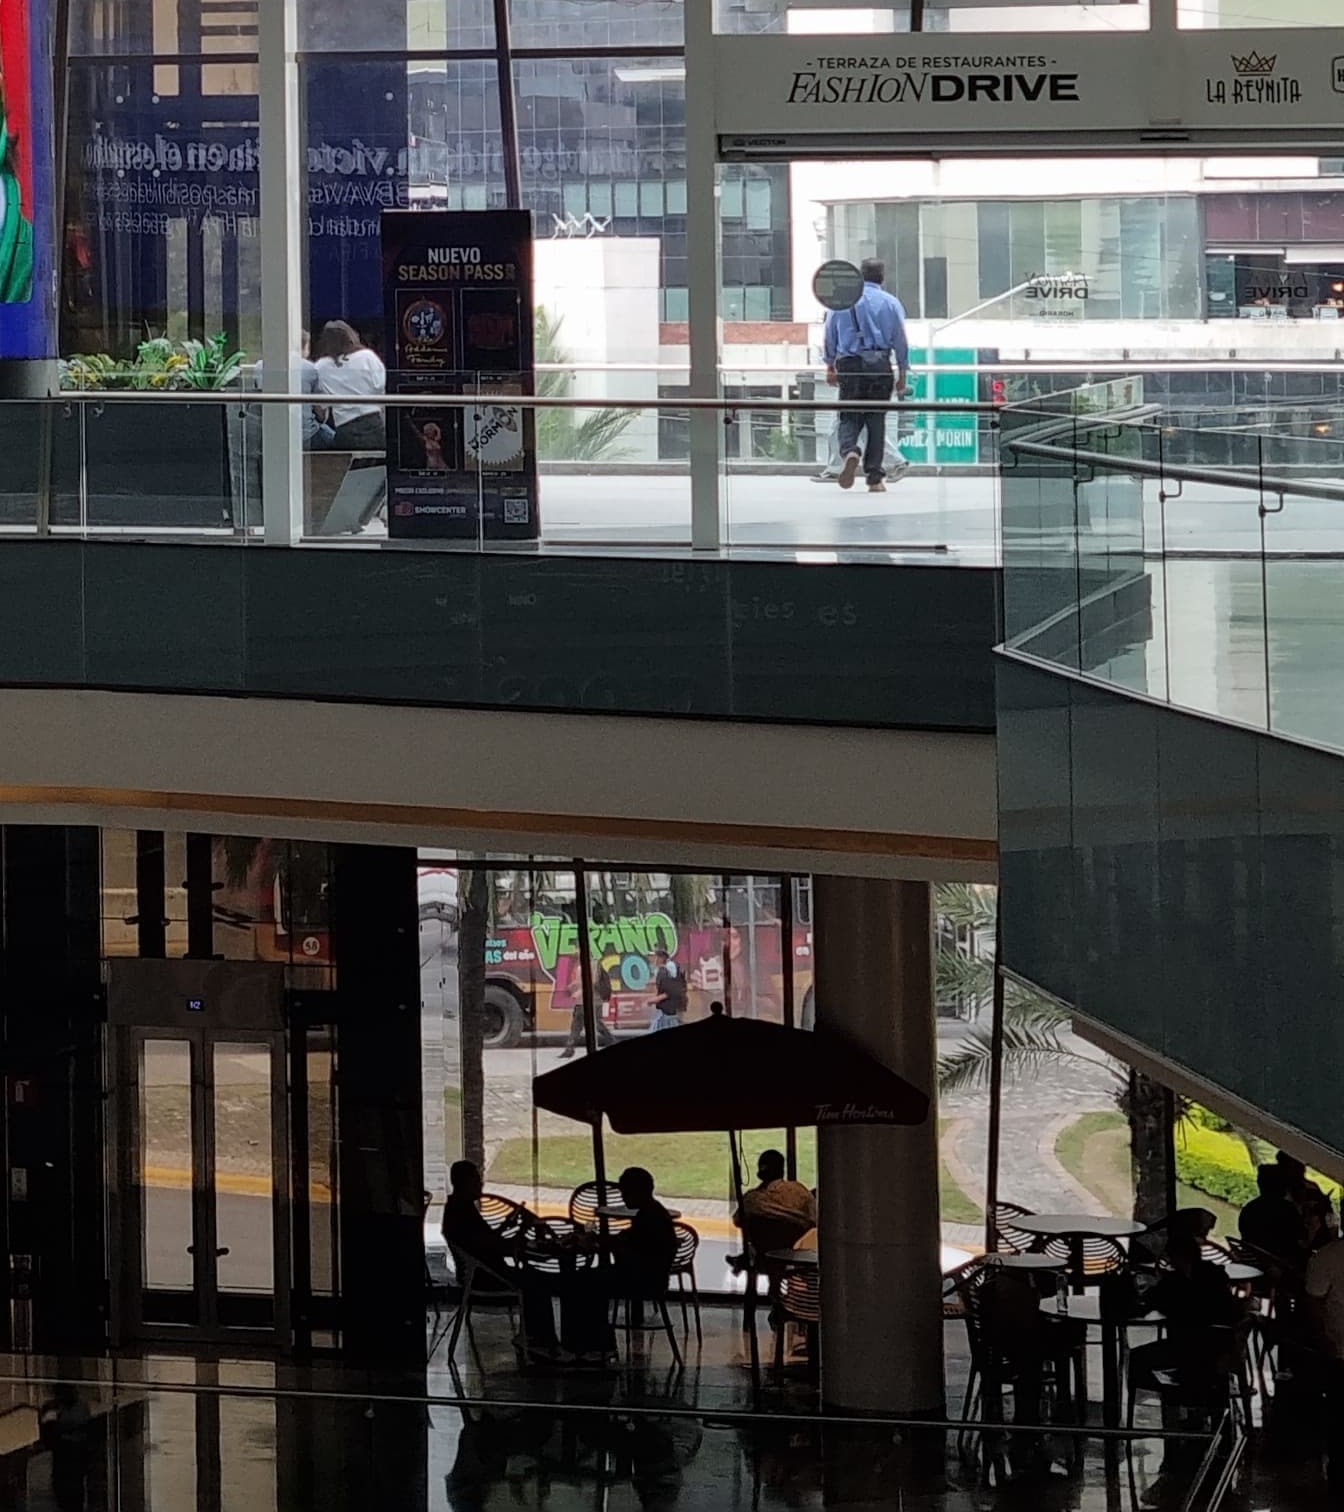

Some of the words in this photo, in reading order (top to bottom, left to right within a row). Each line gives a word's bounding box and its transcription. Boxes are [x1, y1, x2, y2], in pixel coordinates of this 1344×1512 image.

[817, 56, 890, 69] TERRAZA
[897, 56, 916, 69] DE
[921, 55, 1046, 68] RESTAURANTES
[1206, 78, 1226, 105] LA
[1231, 76, 1303, 105] REYNITA
[427, 247, 481, 264] NUEVO
[398, 264, 460, 281] SEASON
